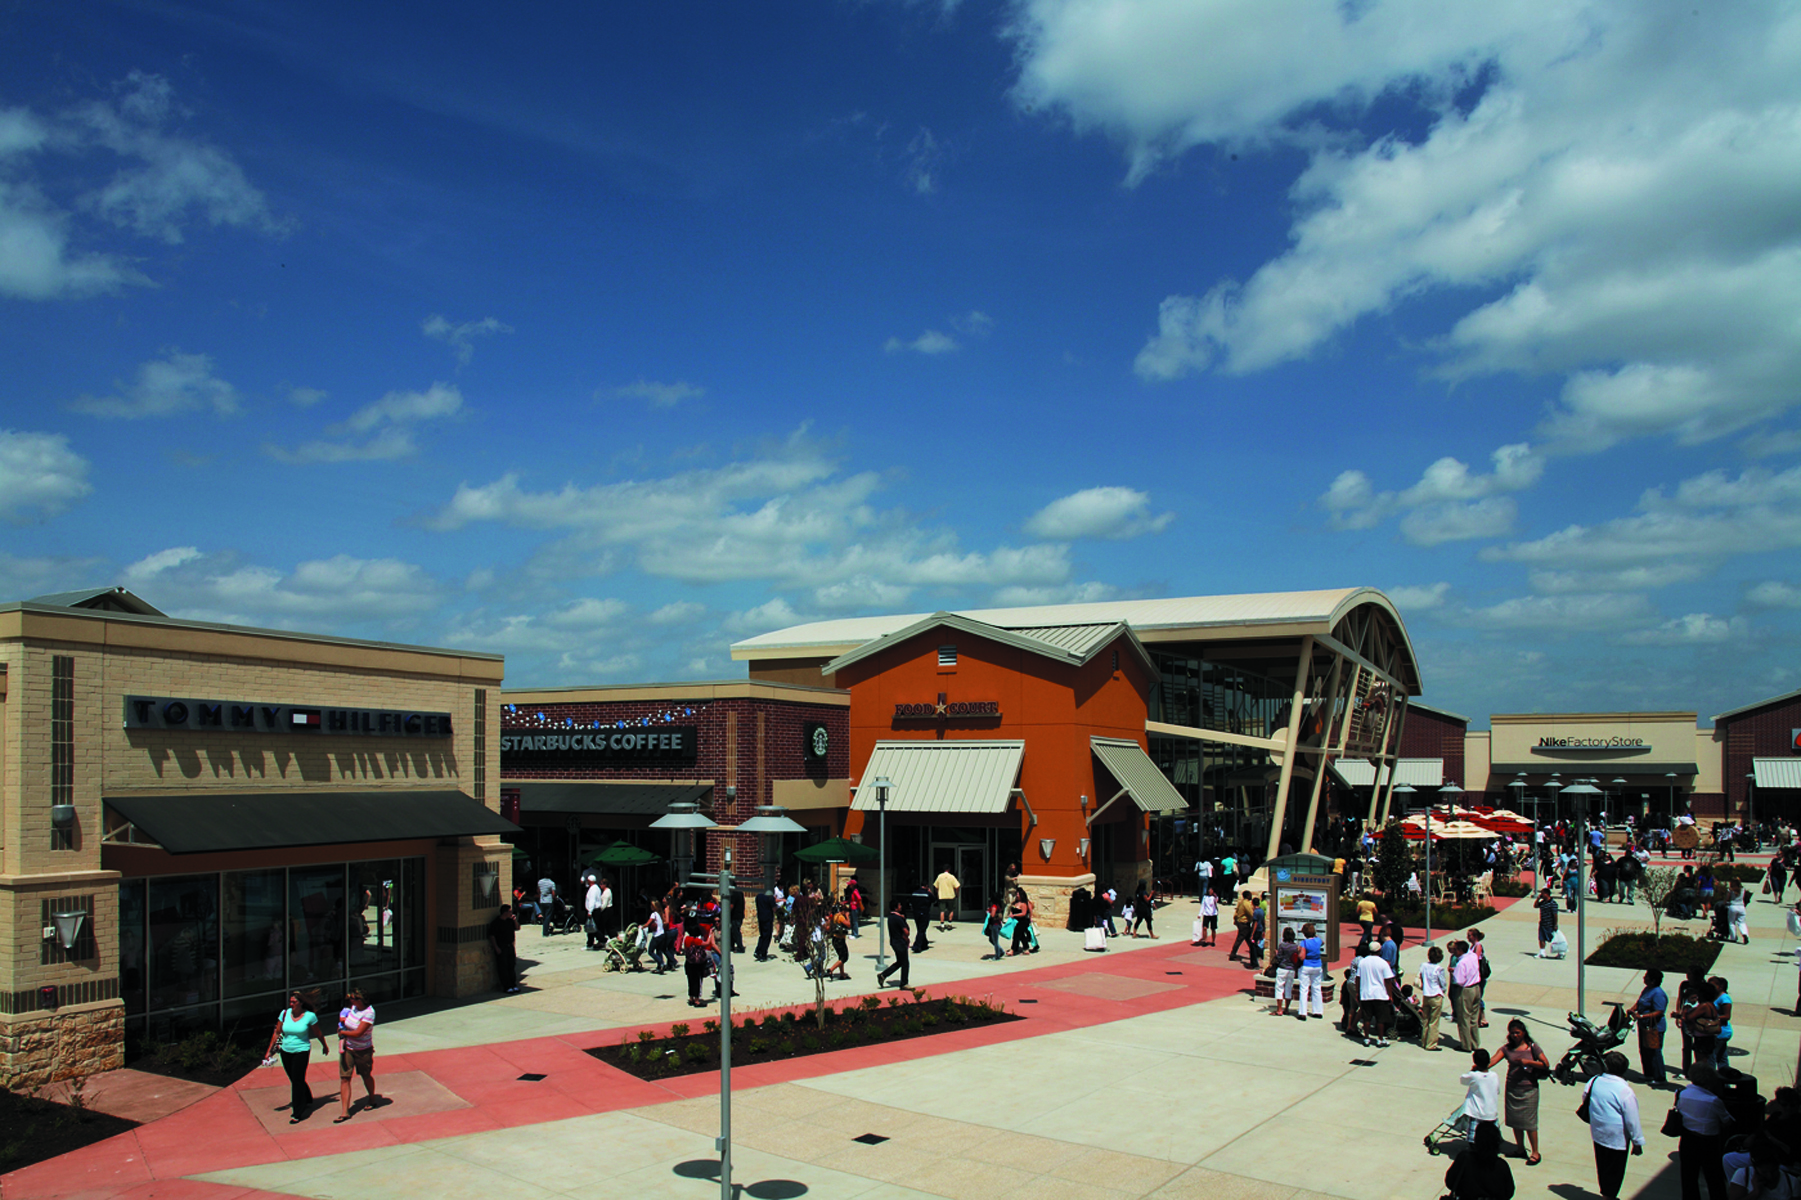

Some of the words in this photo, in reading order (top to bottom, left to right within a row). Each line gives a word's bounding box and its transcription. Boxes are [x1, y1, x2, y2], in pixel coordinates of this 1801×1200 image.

[895, 703, 935, 715] FOOD
[948, 701, 999, 714] COURT
[133, 699, 280, 727] TOMMY
[328, 710, 453, 735] HILFIGER
[501, 734, 606, 751] STARBUCKS
[609, 733, 683, 750] COFFEE
[1293, 876, 1331, 885] DIRECTORY
